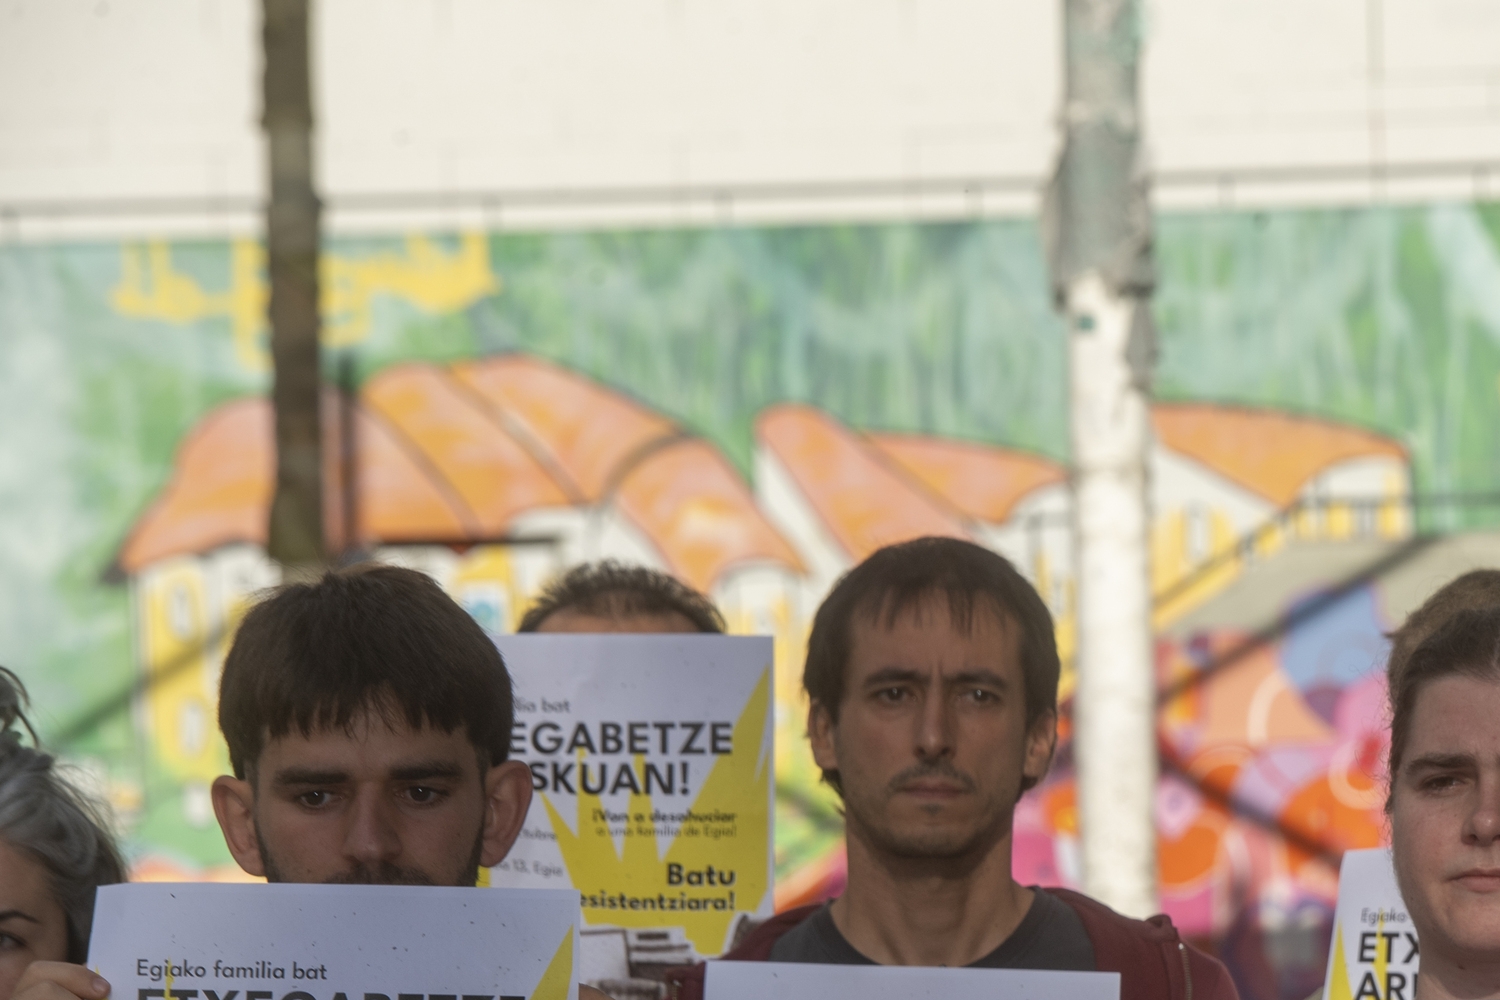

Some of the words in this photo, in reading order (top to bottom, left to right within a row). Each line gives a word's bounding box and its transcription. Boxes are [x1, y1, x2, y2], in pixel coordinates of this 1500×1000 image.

[667, 863, 735, 886] Batu
[137, 958, 207, 982] Egiako
[213, 959, 286, 980] familia
[292, 961, 328, 980] bat
